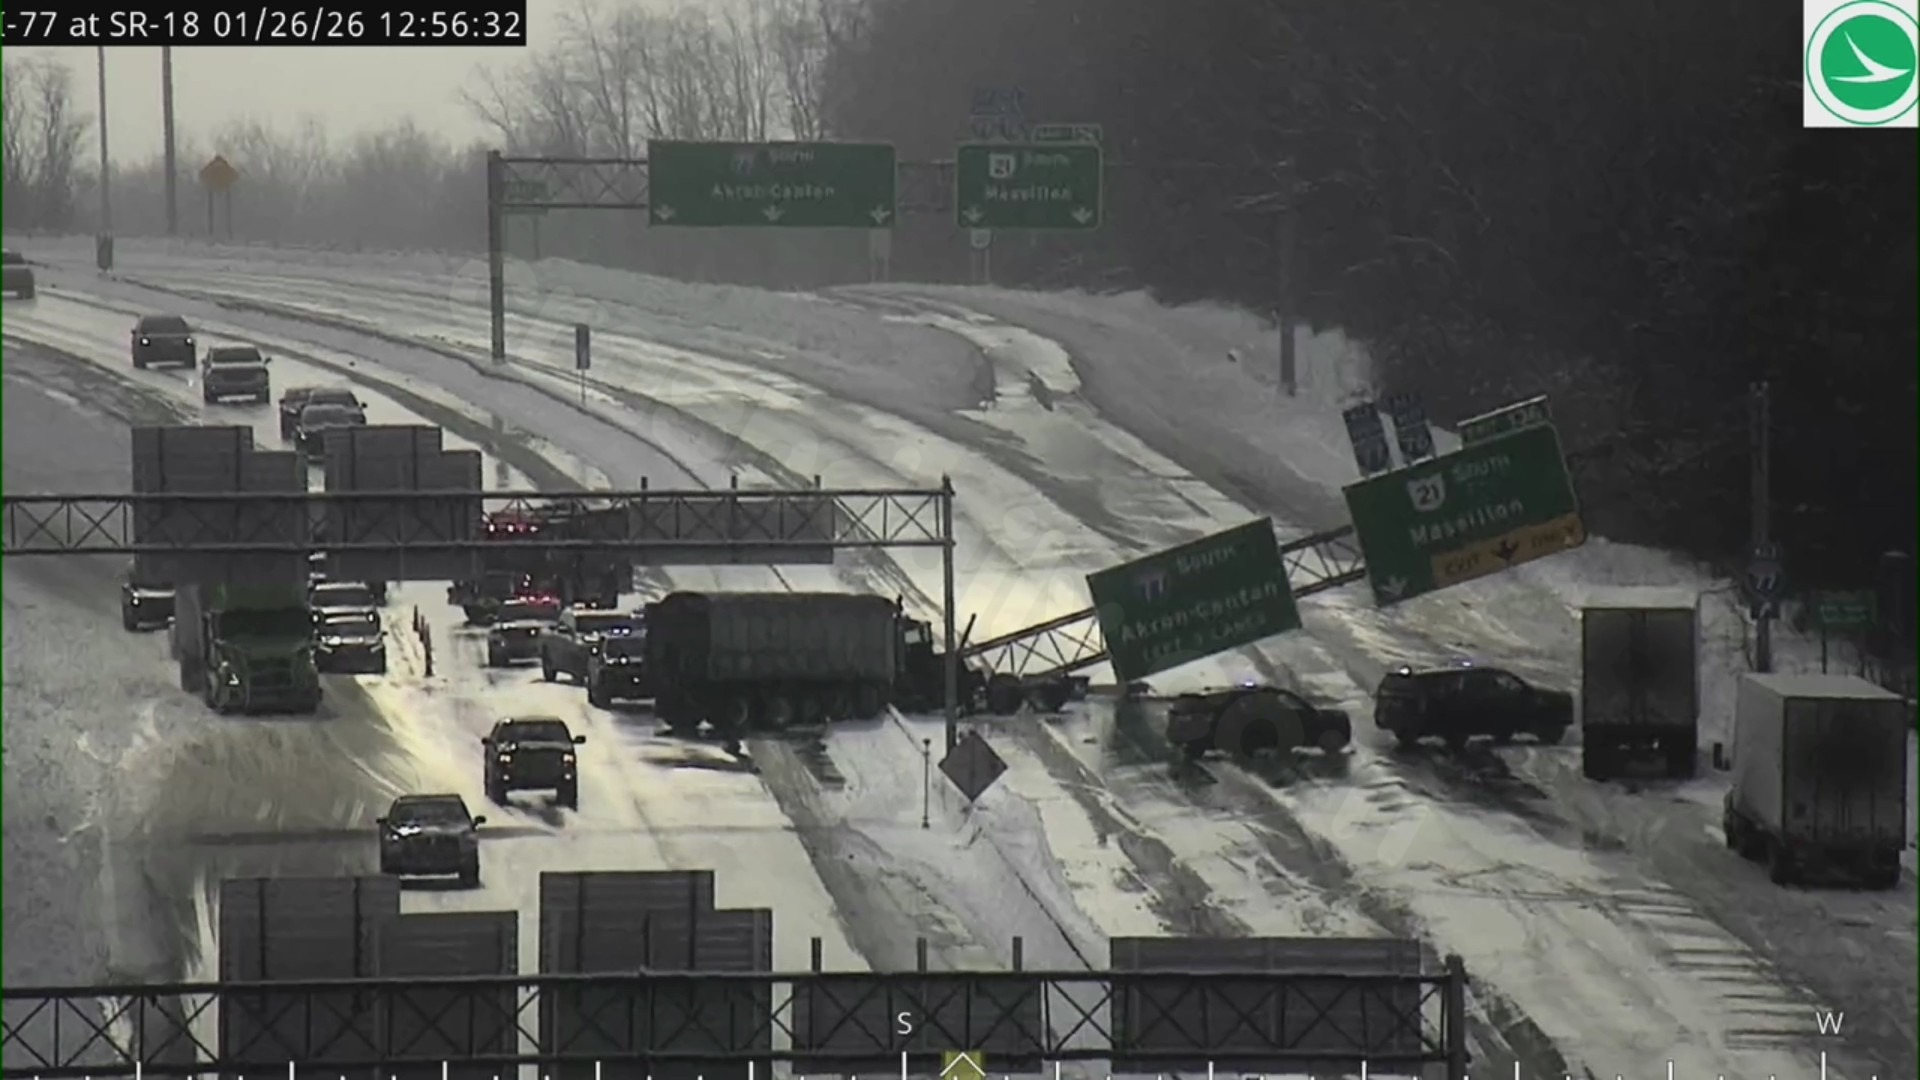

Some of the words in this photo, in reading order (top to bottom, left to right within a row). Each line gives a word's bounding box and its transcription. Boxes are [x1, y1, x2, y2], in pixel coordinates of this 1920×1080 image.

[1417, 482, 1440, 505] 21
[1410, 499, 1524, 545] Massillon
[1121, 580, 1278, 643] Akron-Canton
